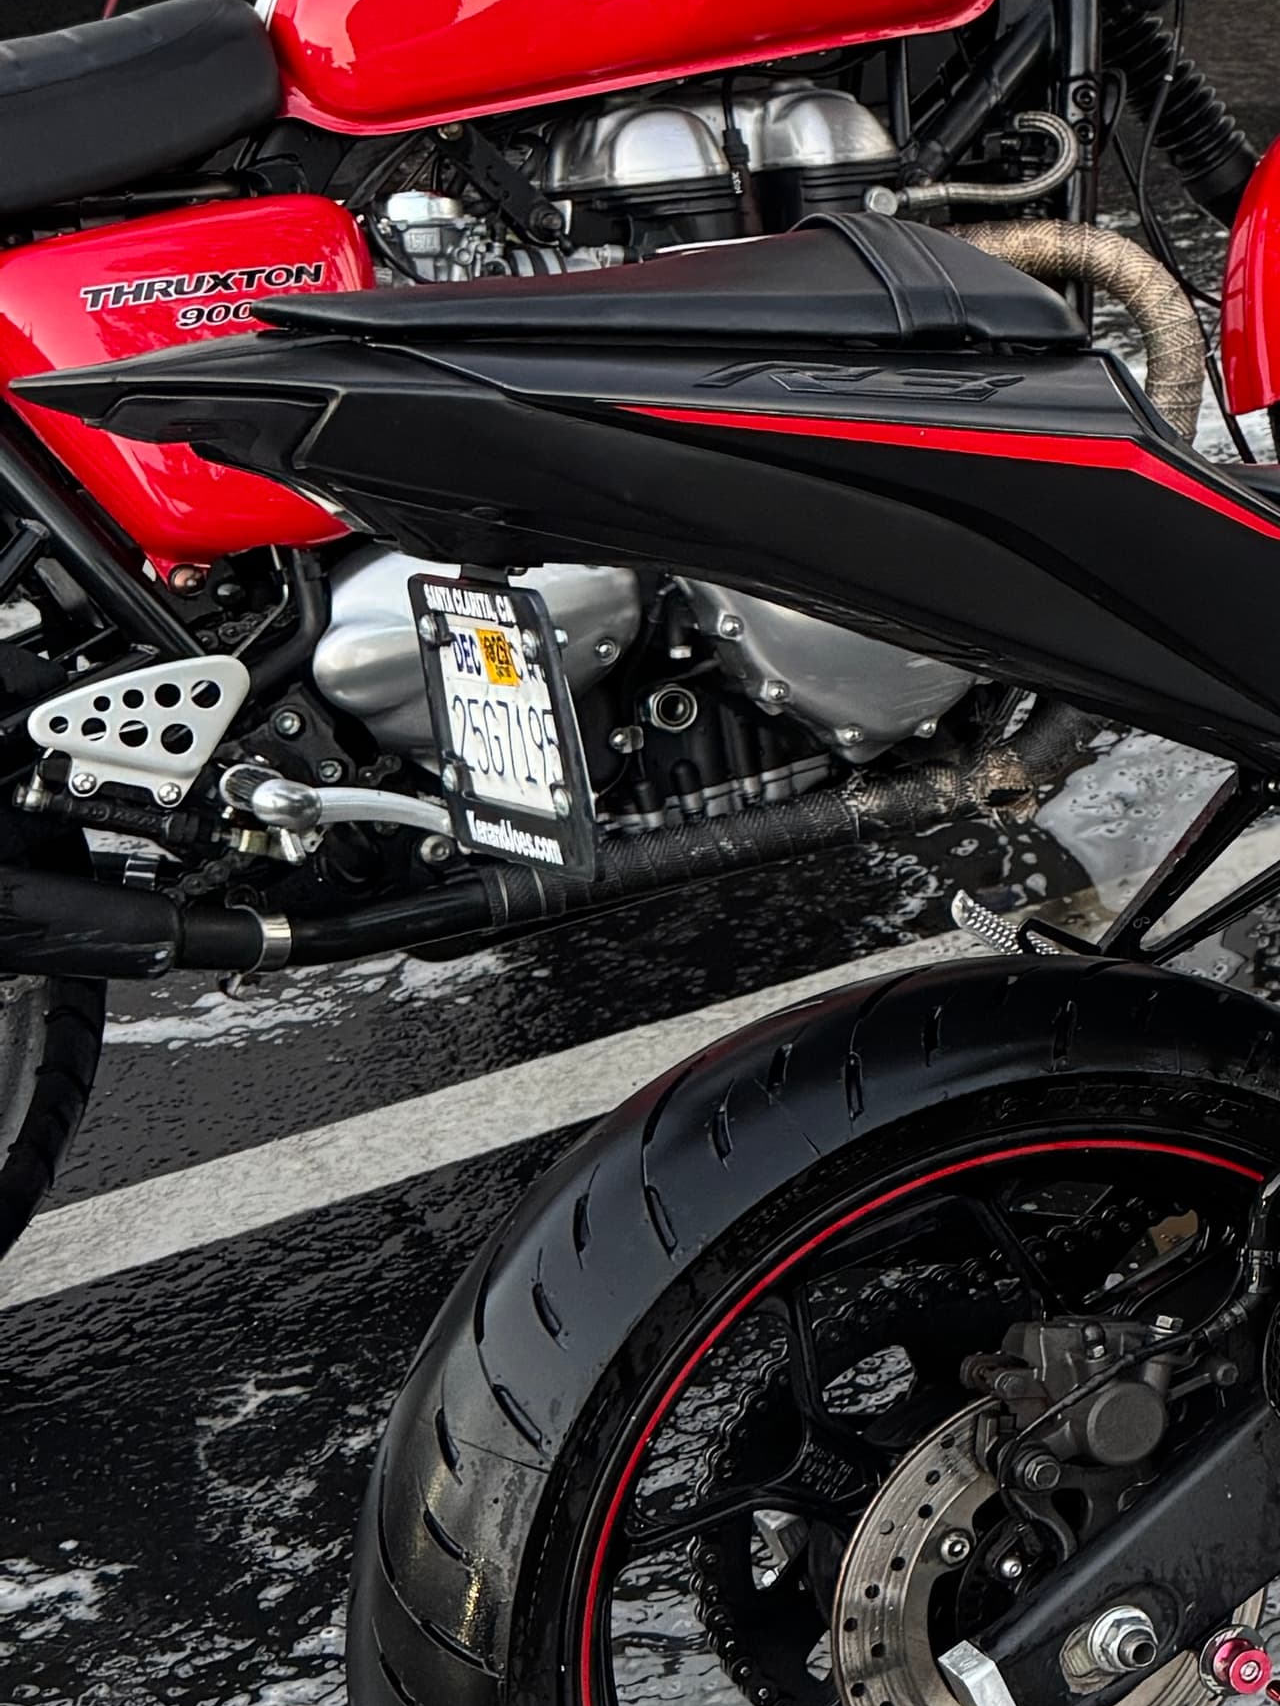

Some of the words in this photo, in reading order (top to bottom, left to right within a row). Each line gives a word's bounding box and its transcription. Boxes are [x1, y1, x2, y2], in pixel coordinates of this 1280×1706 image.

[81, 262, 326, 312] THRUXTON
[176, 300, 257, 330] 900
[424, 583, 456, 613] SANTA
[496, 595, 516, 623] CA
[453, 634, 481, 676] DEC
